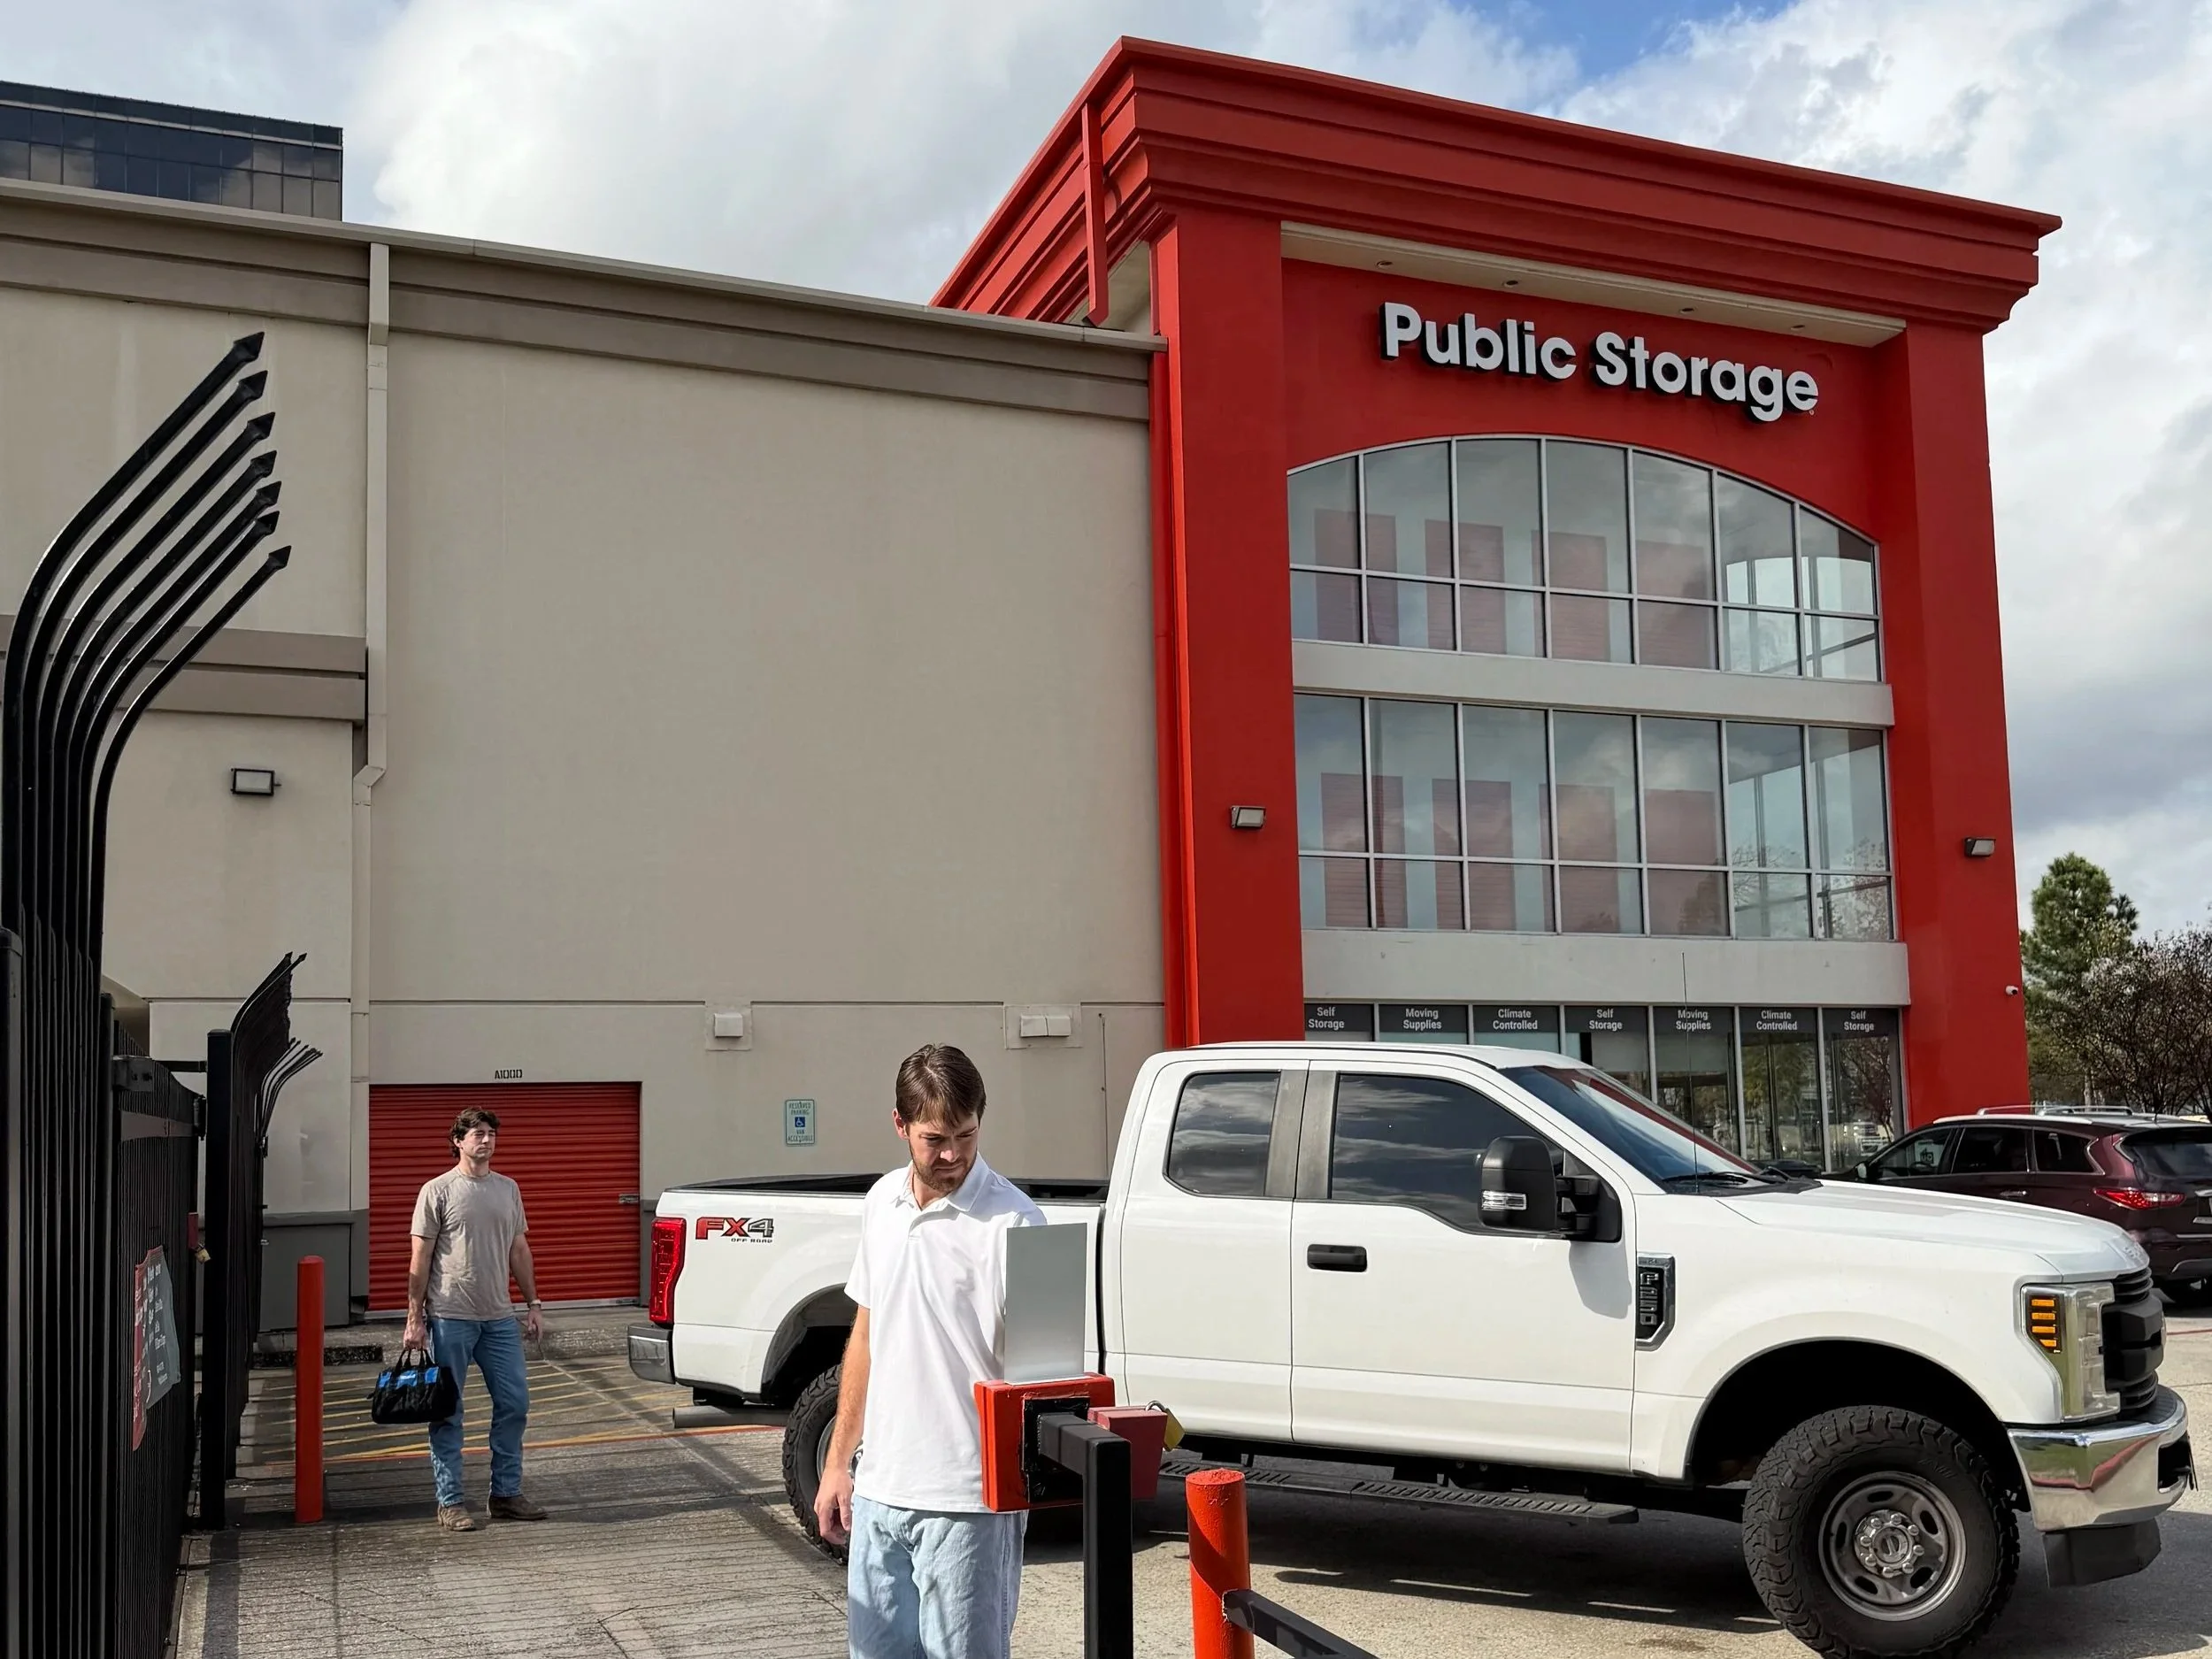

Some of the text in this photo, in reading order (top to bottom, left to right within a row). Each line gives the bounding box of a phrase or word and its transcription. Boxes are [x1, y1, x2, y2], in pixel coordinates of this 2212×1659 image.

[1384, 301, 1819, 422] Public Storage
[1317, 1006, 1335, 1017] Self
[1405, 1008, 1440, 1019] Moving
[1497, 1009, 1532, 1018] Climate
[1596, 1009, 1614, 1018] Self
[1678, 1009, 1709, 1020] Moving
[1761, 1010, 1792, 1020] Climate
[1850, 1010, 1867, 1020] Self
[1308, 1018, 1345, 1031] Storage
[1402, 1018, 1442, 1031] Supplies
[1492, 1019, 1539, 1031] Controlled
[1589, 1019, 1623, 1032] Storage
[1675, 1020, 1711, 1032] Supplies
[1755, 1020, 1798, 1031] Controlled
[1843, 1021, 1875, 1033] Storage
[495, 1069, 523, 1079] A1000
[695, 1217, 774, 1240] FX4
